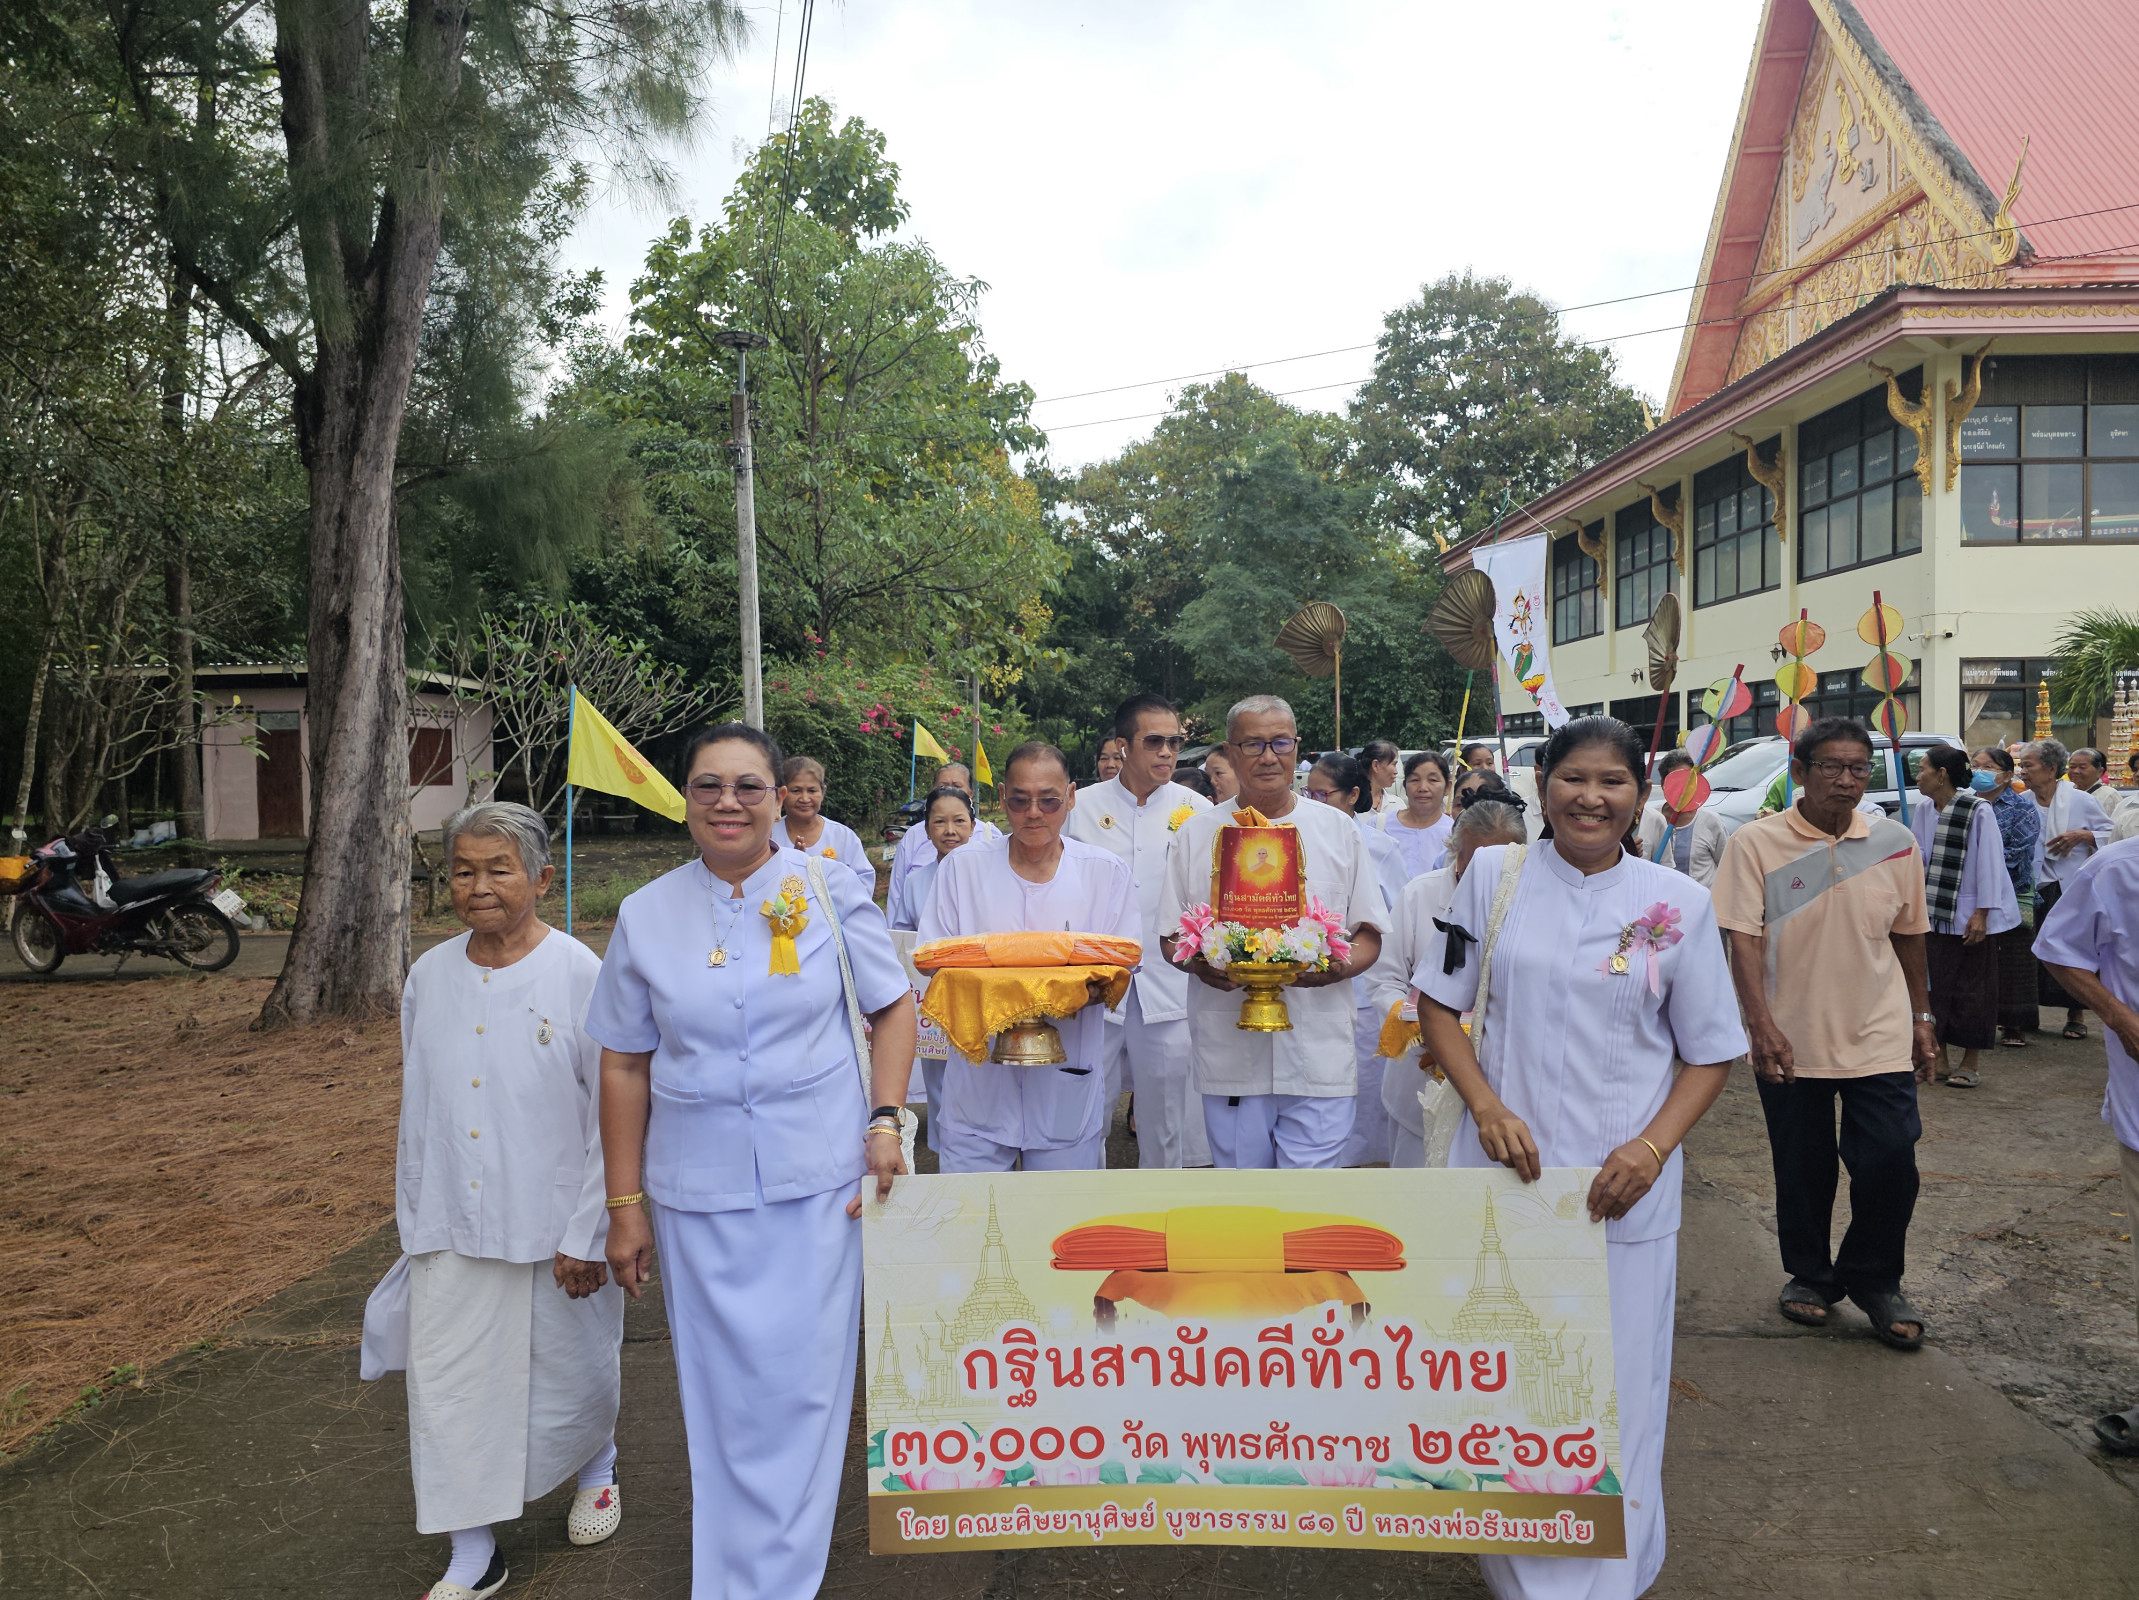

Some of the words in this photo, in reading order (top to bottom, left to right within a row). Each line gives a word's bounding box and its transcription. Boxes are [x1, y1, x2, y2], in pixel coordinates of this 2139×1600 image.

[963, 1308, 1508, 1408] กฐินสามัคคีทั่วไทย
[891, 1425, 1105, 1473] ๓๐,๐๐๐
[1122, 1419, 1169, 1459] วัด
[1181, 1420, 1390, 1474] พุทธศักราช
[1408, 1422, 1597, 1469] ๒๕๖๘
[899, 1511, 947, 1537] โดย
[958, 1501, 1155, 1538] คณะศิษยานุศิษย์
[1166, 1511, 1286, 1538] บูชาธรรม
[1298, 1514, 1335, 1533] ๘๑
[1345, 1507, 1363, 1533] ปี
[1375, 1511, 1593, 1541] หลวงพ่อธัมมชโย
